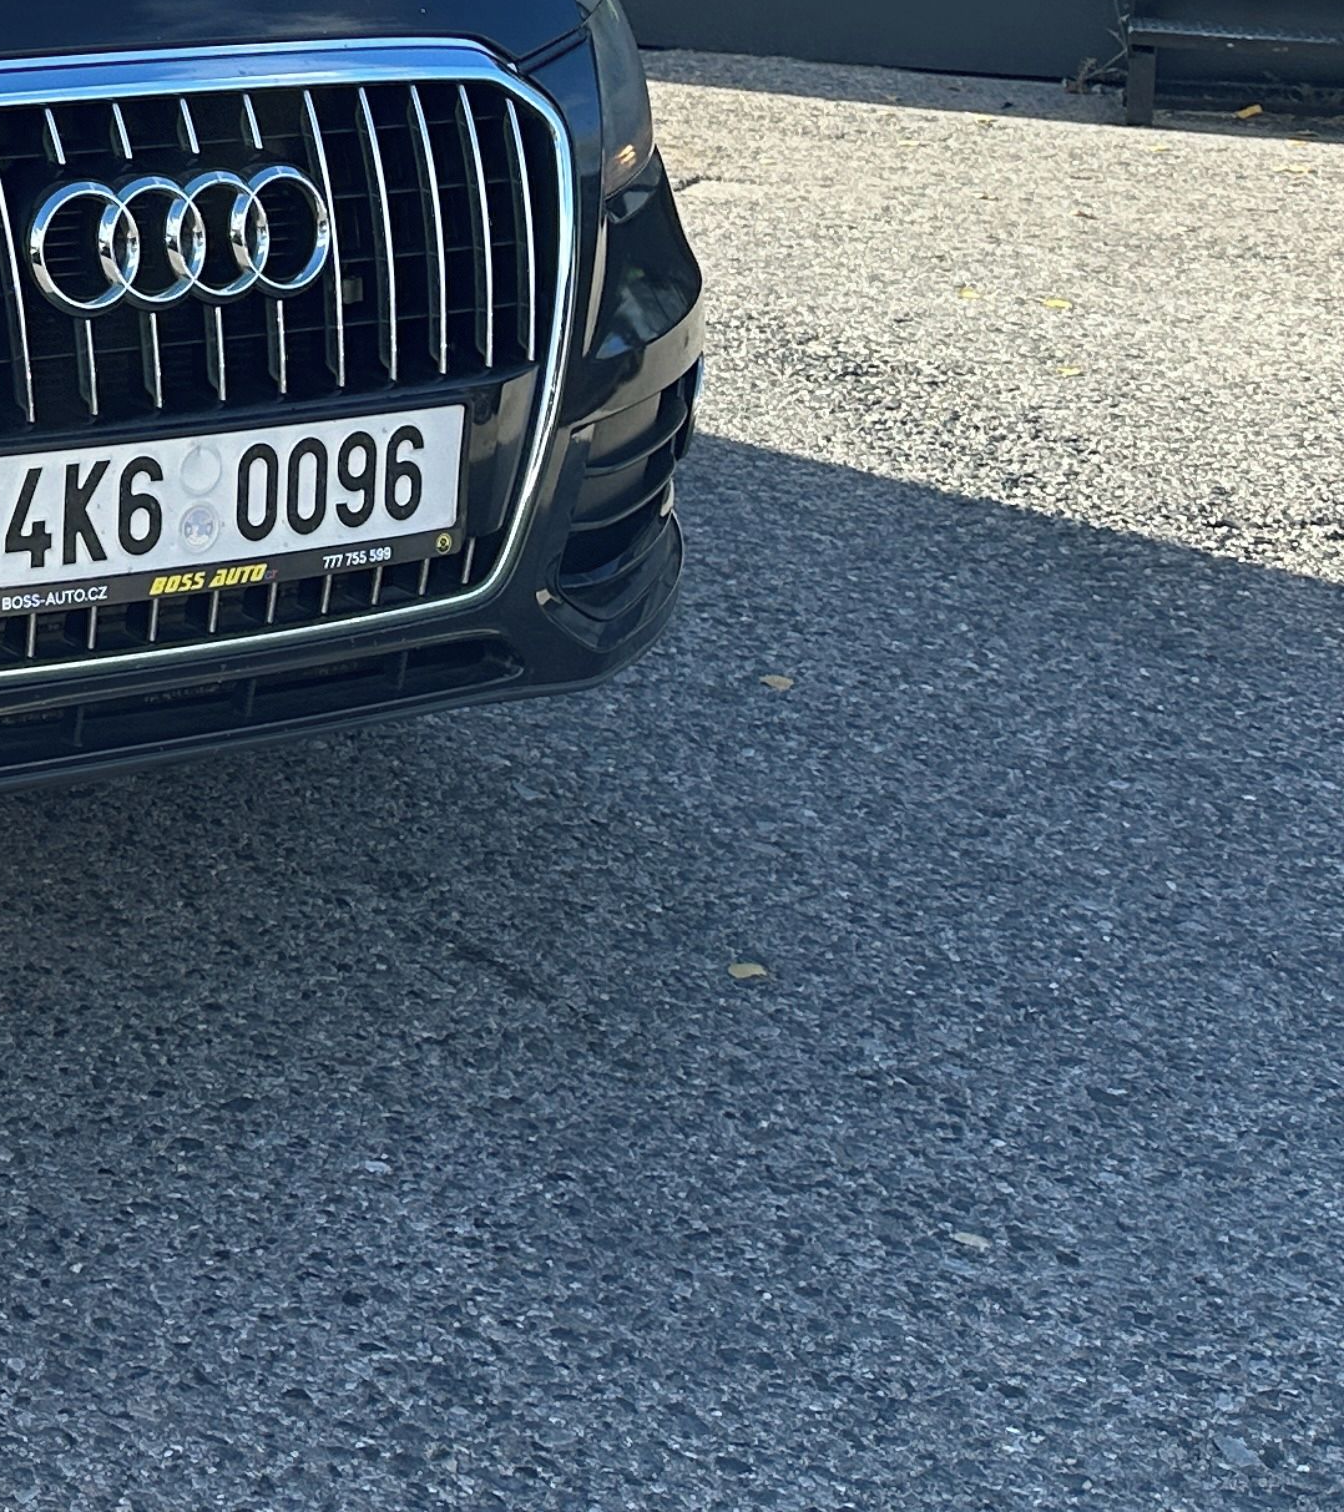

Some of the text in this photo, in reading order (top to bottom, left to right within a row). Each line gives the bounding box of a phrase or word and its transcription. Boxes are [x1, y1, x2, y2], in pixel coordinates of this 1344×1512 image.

[4, 425, 425, 569] 4K6 0096
[322, 547, 391, 569] 777 755 599
[149, 571, 206, 596] BOSS
[208, 563, 268, 588] AUTO
[2, 586, 108, 611] BOSS-AUTO.CZ
